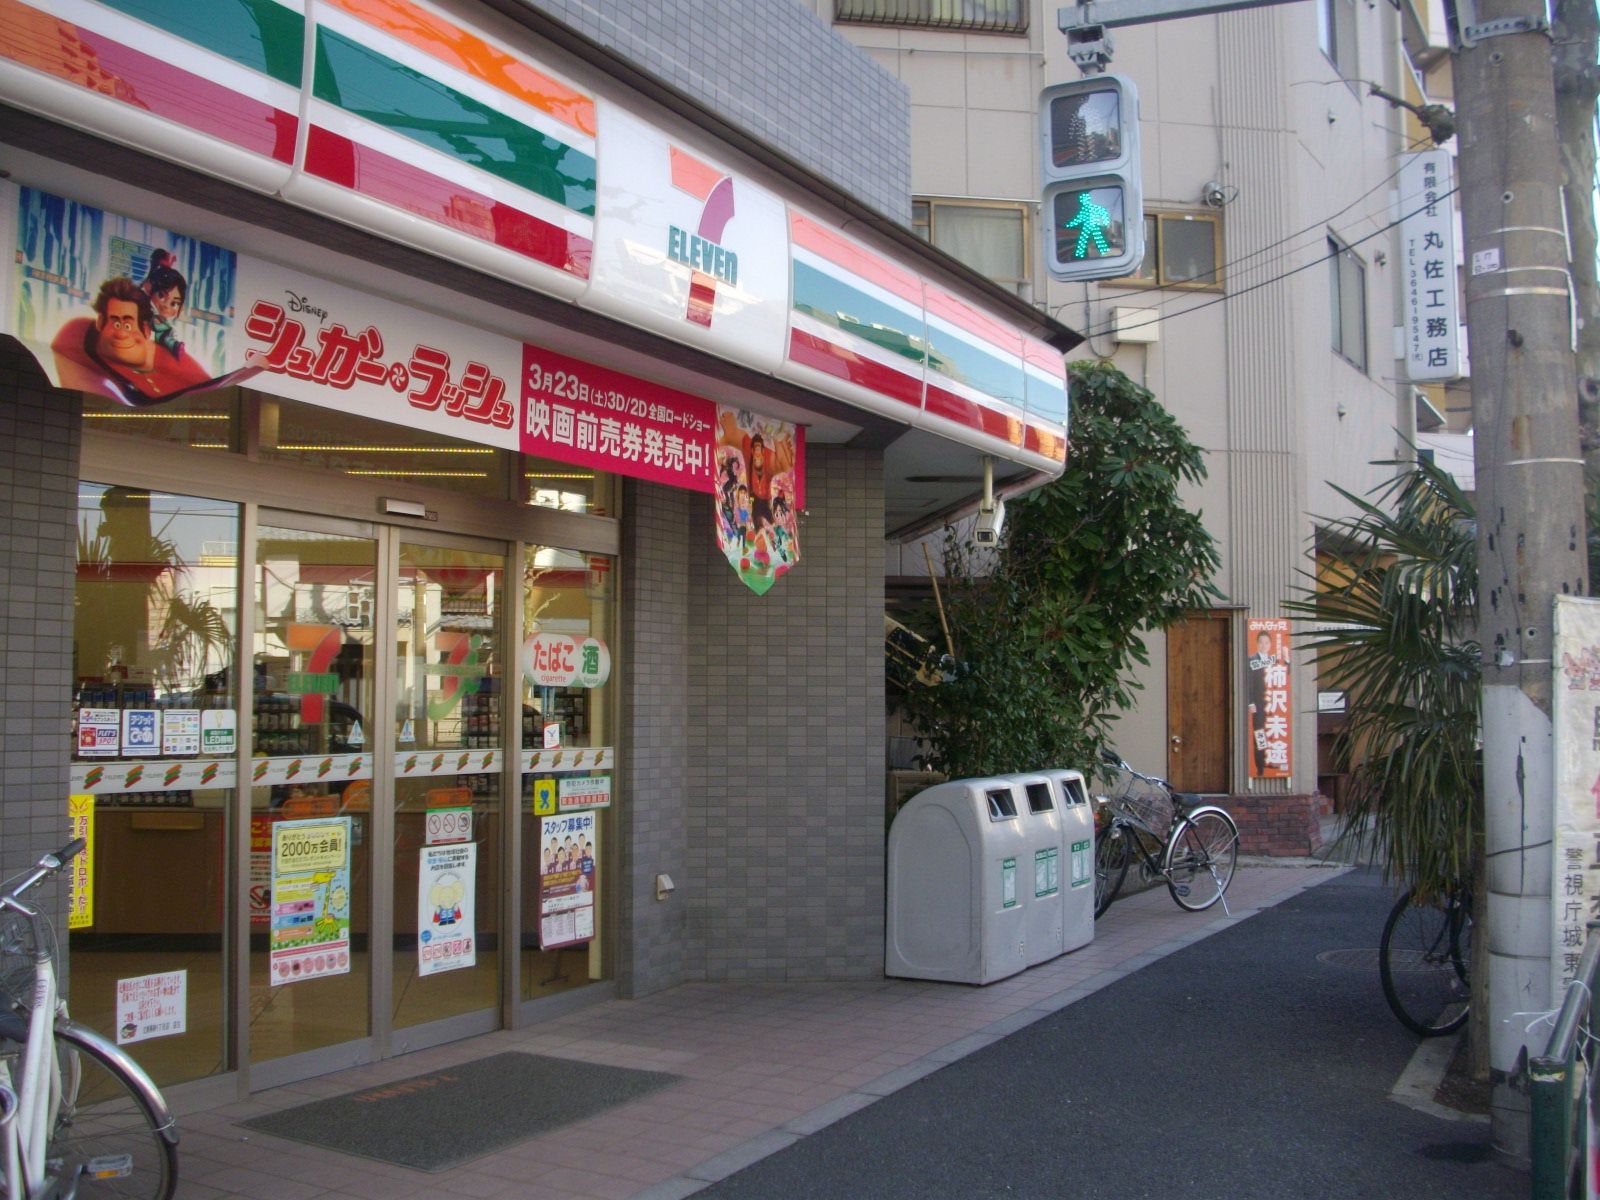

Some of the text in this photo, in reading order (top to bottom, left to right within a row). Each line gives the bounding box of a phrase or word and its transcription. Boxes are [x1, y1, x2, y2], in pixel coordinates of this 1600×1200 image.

[669, 144, 735, 328] 7
[1423, 162, 1448, 367] 有限会社 丸佐工務店
[533, 640, 599, 674] たばこ 酒
[543, 815, 593, 835] スタッフ募集中!
[281, 838, 342, 857] 2000万会員!
